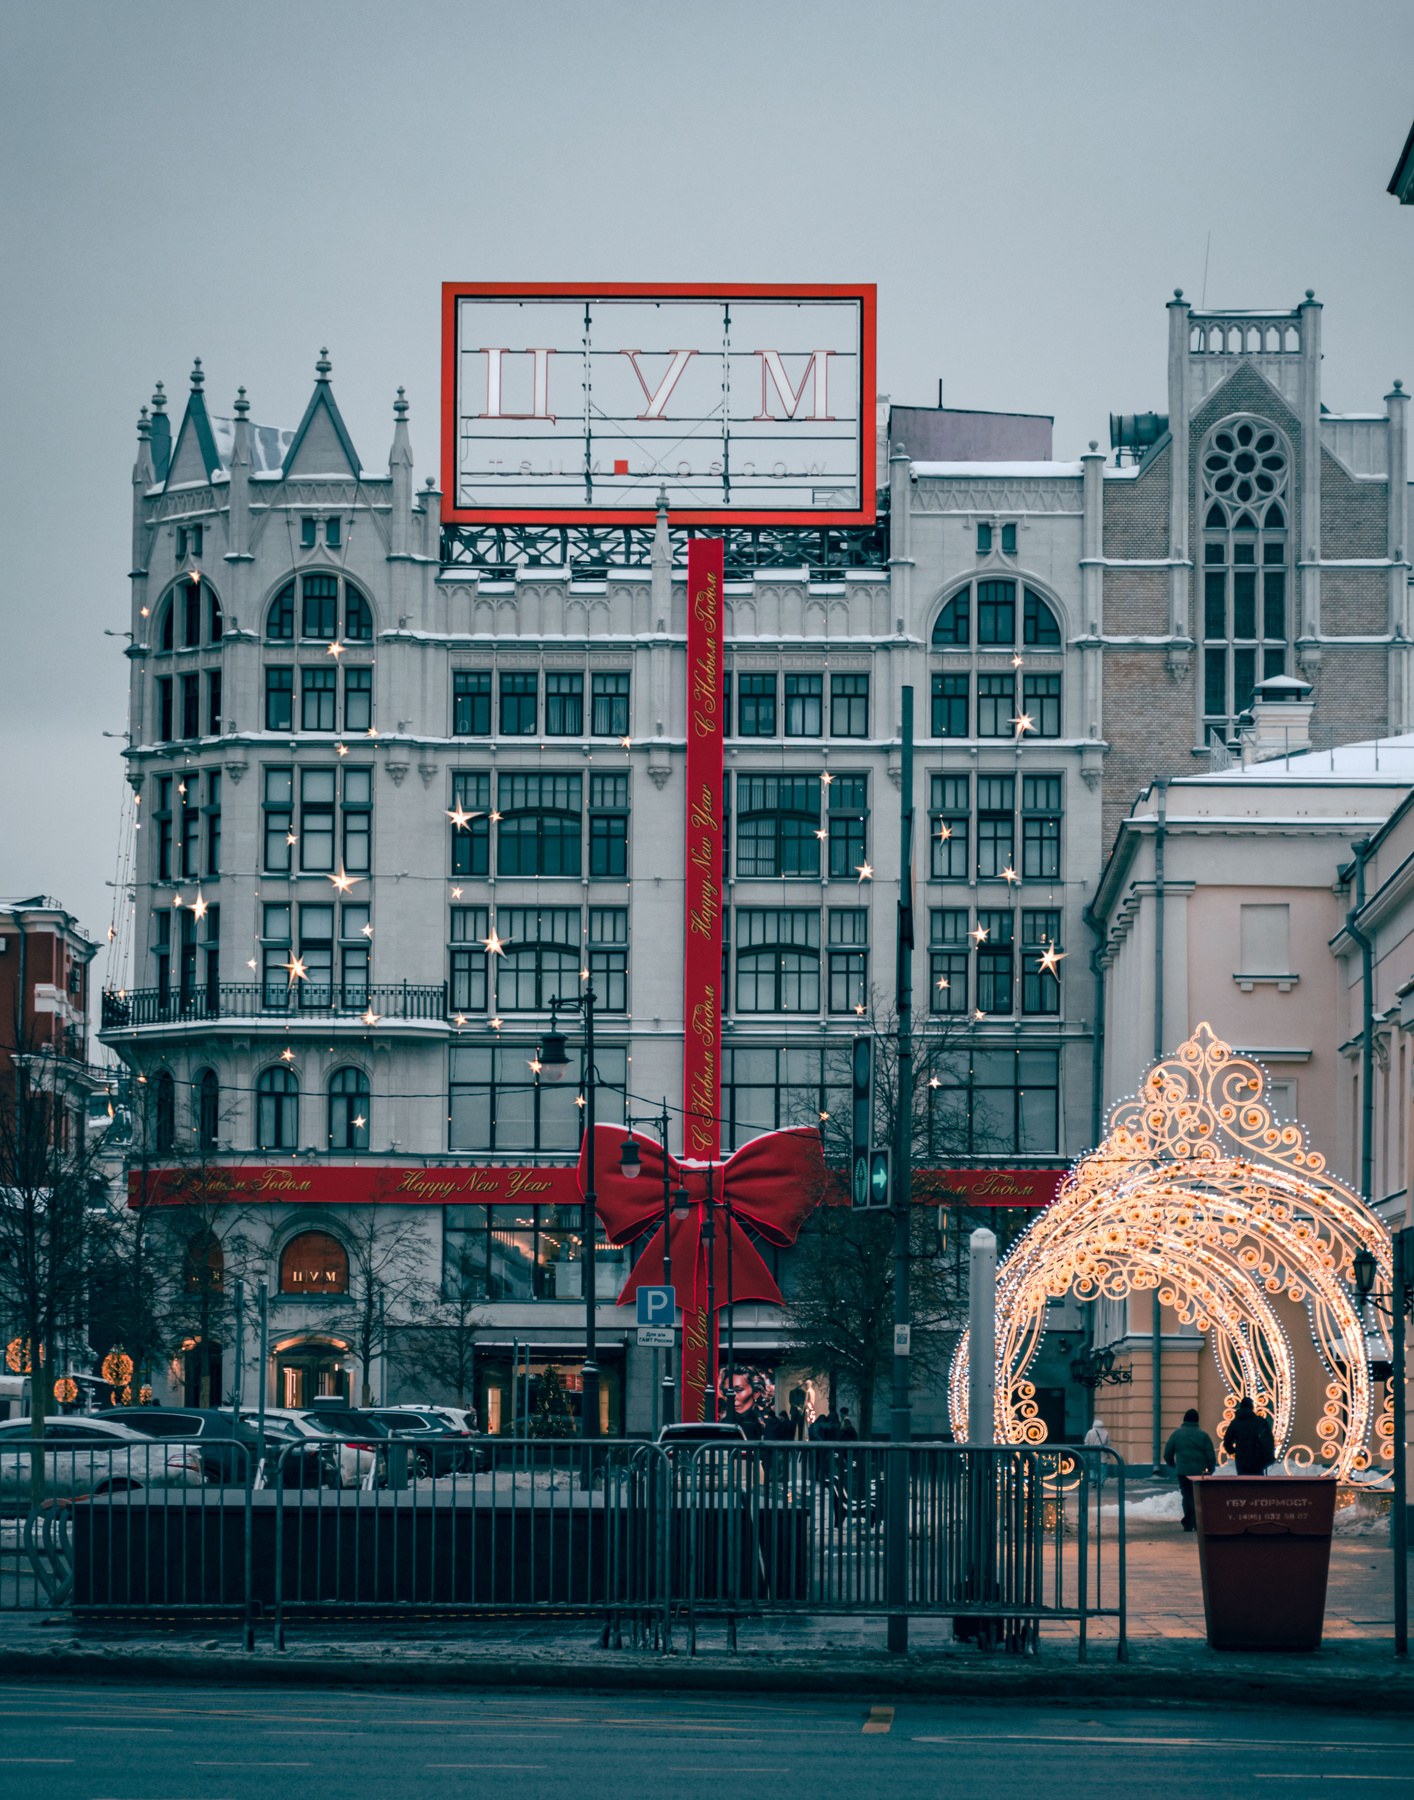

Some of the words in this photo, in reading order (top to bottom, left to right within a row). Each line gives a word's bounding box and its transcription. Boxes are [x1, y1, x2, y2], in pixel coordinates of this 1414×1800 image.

[478, 347, 837, 426] ЦУМ
[488, 459, 601, 477] TSUM
[640, 460, 828, 478] MOSCOW
[694, 570, 718, 634] Годом
[693, 635, 718, 714] Новым
[691, 782, 720, 832] Year
[691, 835, 713, 880] New
[691, 876, 719, 941] Happy
[692, 984, 715, 1047] Годом
[691, 1050, 715, 1128] Новым
[250, 1168, 312, 1192] Годом
[396, 1170, 457, 1199] Happy
[456, 1170, 500, 1192] New
[504, 1170, 553, 1198] Year
[972, 1173, 1034, 1196] Годом
[648, 1290, 668, 1320] P
[686, 1305, 709, 1350] Year
[1226, 1499, 1247, 1507] ГБУ
